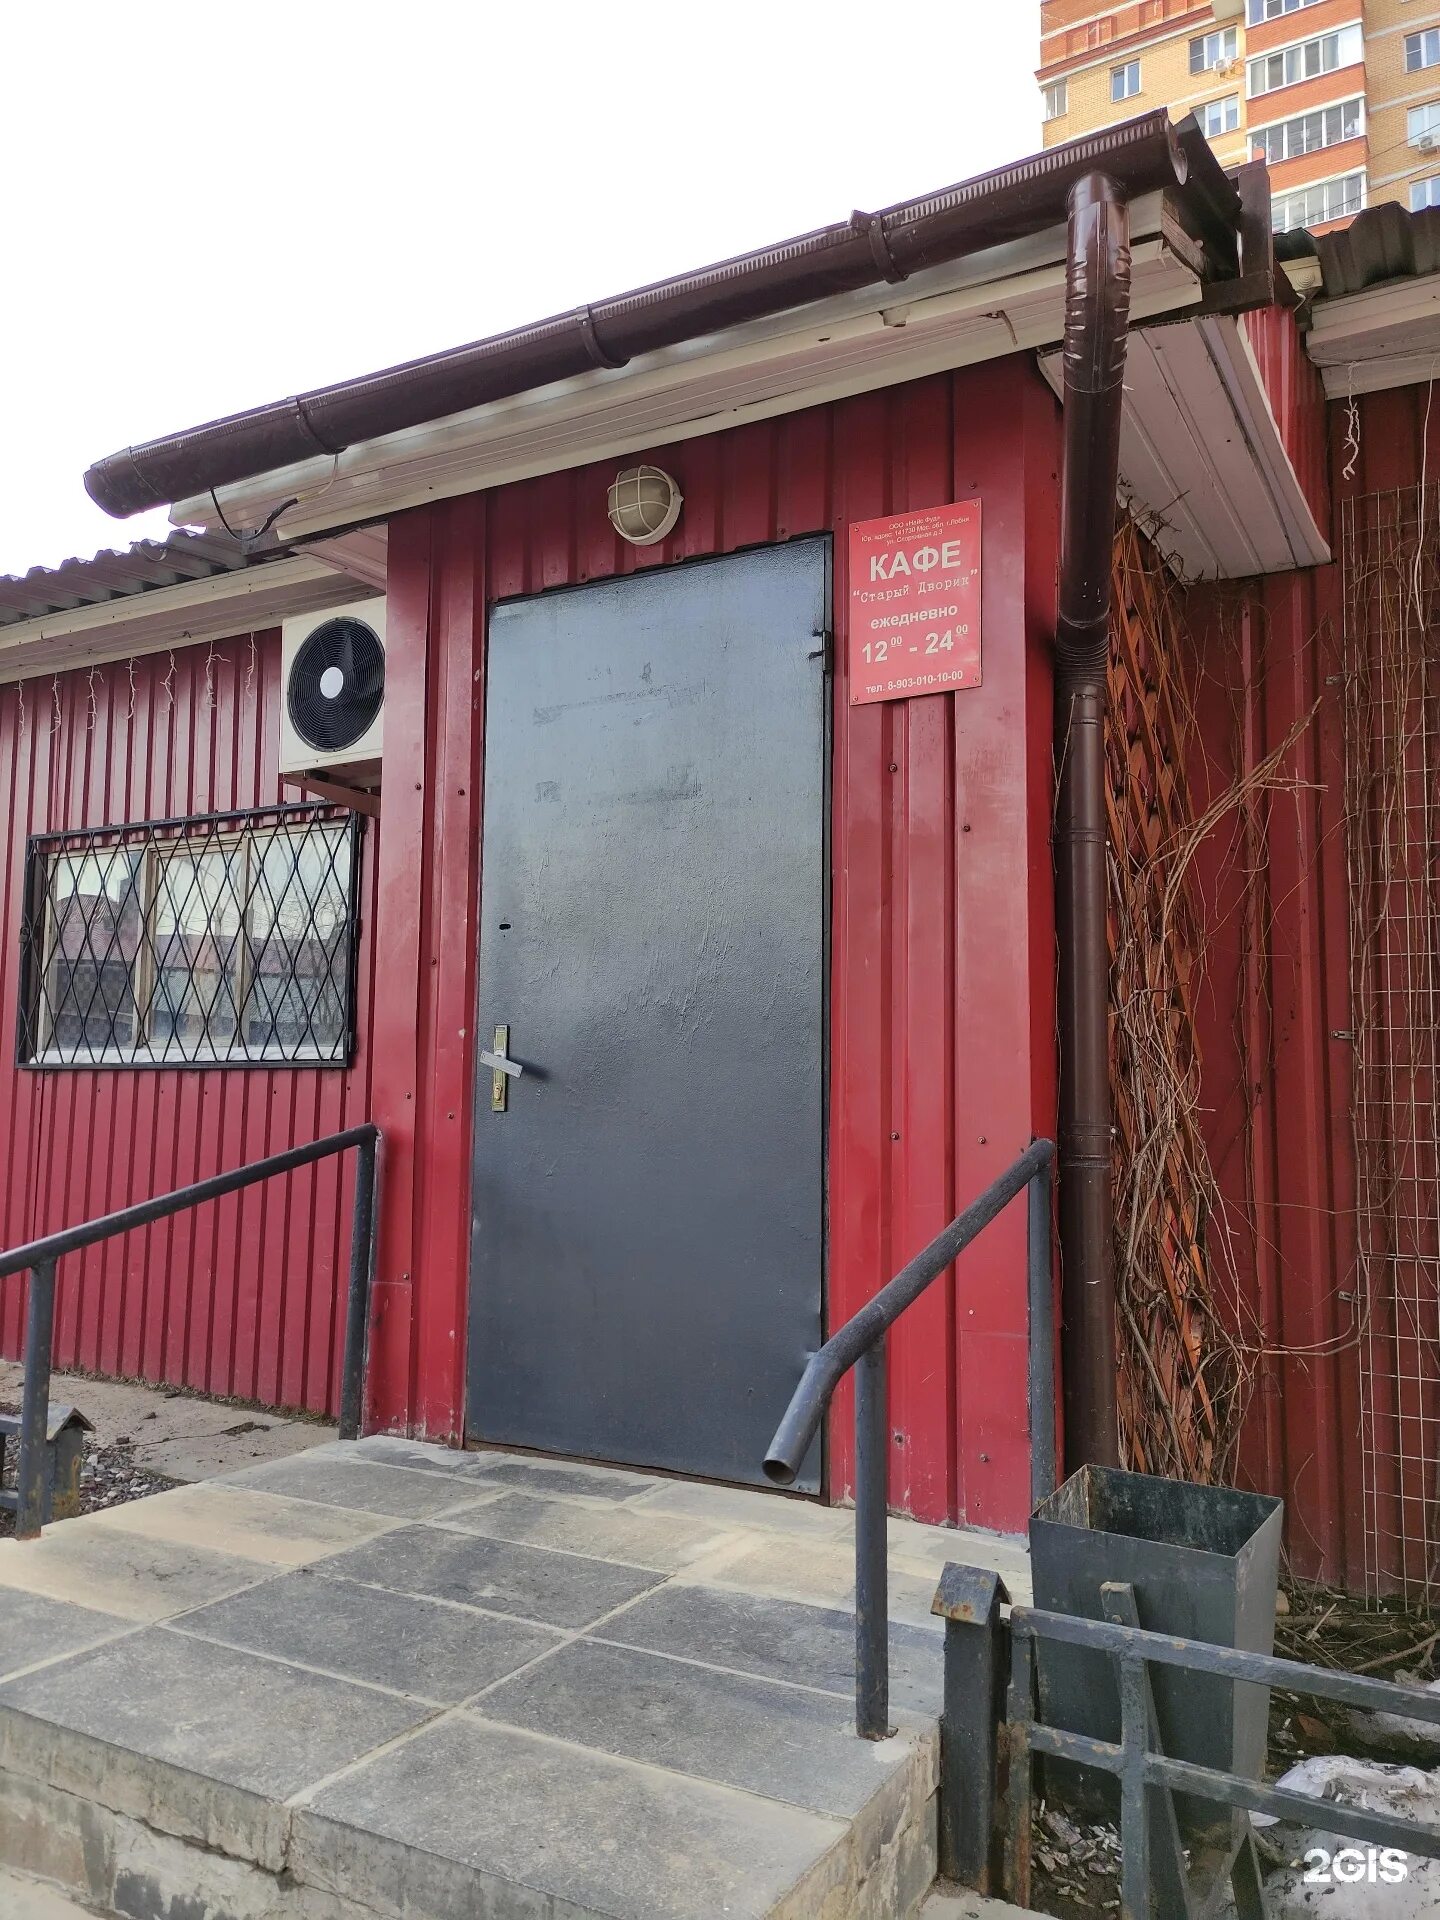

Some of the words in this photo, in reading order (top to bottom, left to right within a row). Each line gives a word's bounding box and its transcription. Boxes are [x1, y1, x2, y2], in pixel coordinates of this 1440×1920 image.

[869, 539, 962, 583] КАФЕ
[870, 605, 958, 630] ежедневно
[865, 684, 885, 694] тел.
[887, 670, 963, 691] 8-903-010-10-00
